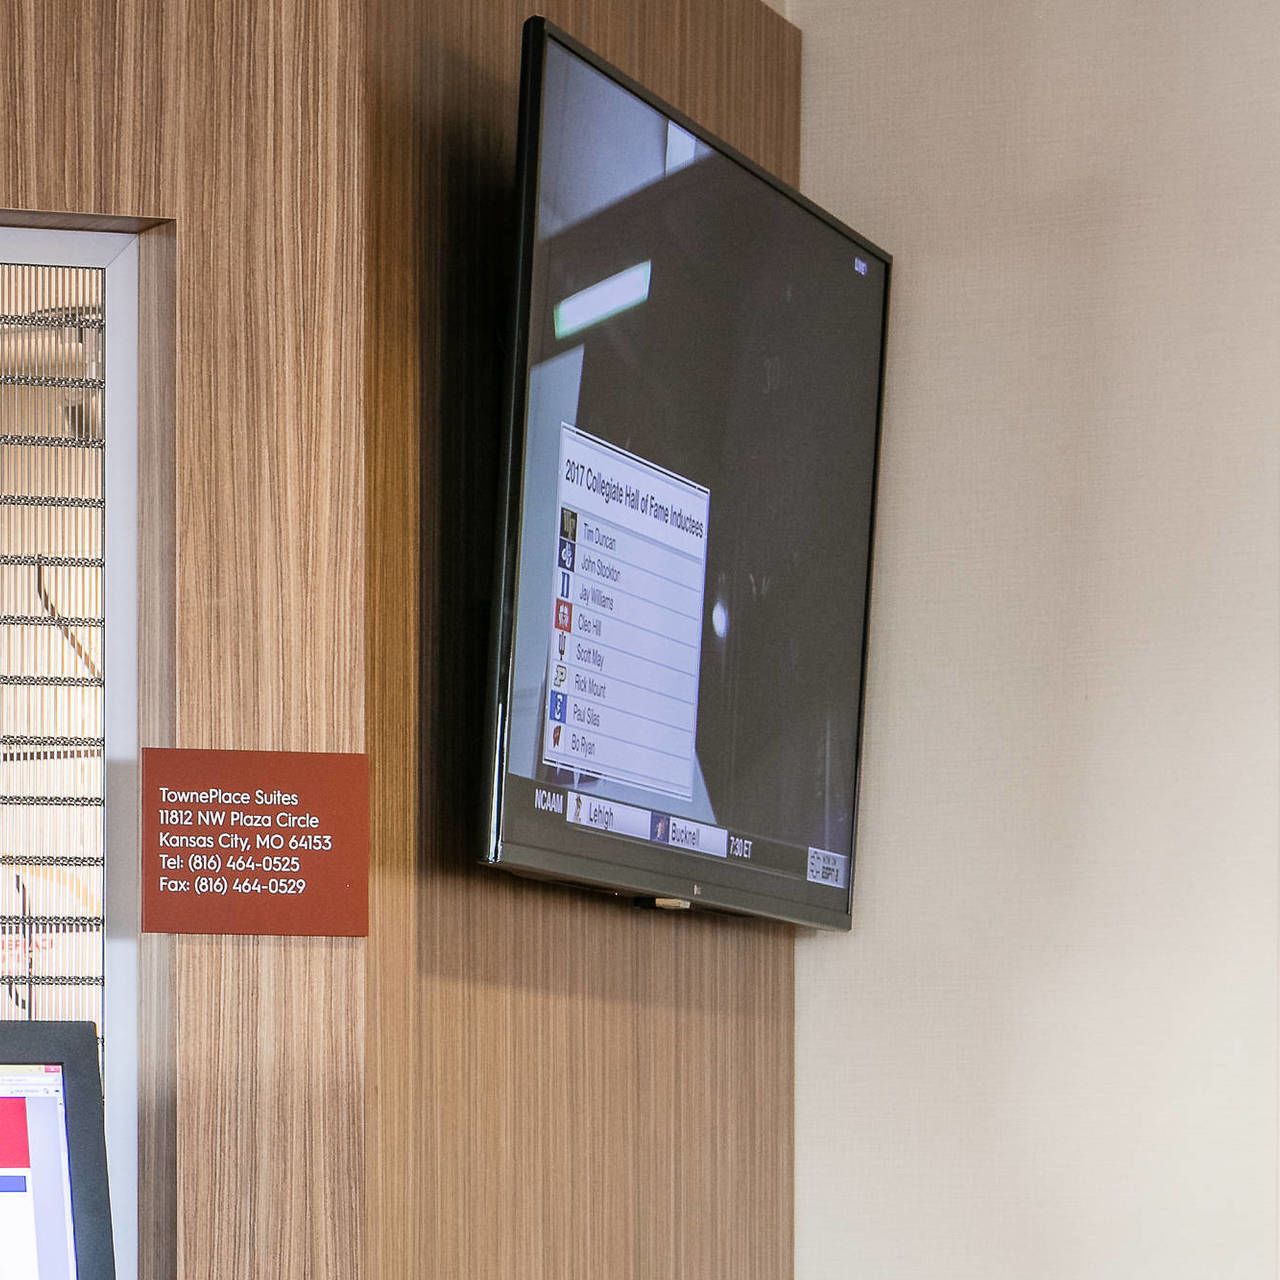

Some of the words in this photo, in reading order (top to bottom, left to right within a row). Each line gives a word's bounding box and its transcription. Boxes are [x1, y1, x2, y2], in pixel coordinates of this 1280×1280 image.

[565, 458, 585, 487] 2017
[586, 468, 624, 504] Collegiate
[625, 484, 640, 511] Hall
[641, 493, 649, 513] of
[649, 496, 669, 524] Fame
[670, 505, 704, 538] Inductees
[584, 522, 594, 541] Tim
[595, 528, 617, 551] Duncan
[581, 554, 596, 572] John
[596, 559, 621, 582] Stockton
[579, 583, 590, 605] Jay
[591, 585, 614, 611] Williams
[578, 613, 592, 633] Cleo
[576, 643, 592, 663] Scott
[592, 648, 605, 671] May
[575, 674, 587, 692] Rick
[589, 677, 606, 699] Mount
[573, 703, 586, 722] Paul
[587, 707, 600, 728] Silas
[571, 734, 580, 752] Bo
[581, 736, 596, 758] Ryan
[159, 787, 250, 805] TownePlace
[255, 789, 299, 806] Suites
[159, 809, 192, 826] 11812
[197, 811, 226, 826] NW
[230, 812, 272, 827] Plaza
[276, 812, 320, 828] Circle
[534, 788, 563, 814] NCAAM
[589, 802, 614, 830] Lehigh
[671, 821, 700, 847] Bucknell
[729, 836, 743, 857] 7:30
[743, 840, 753, 859] ET
[159, 832, 214, 848] Kansas
[218, 833, 251, 852] City,
[256, 834, 284, 850] MO
[288, 835, 332, 851] 64153
[159, 854, 184, 870] Tel:
[188, 854, 221, 873] (816)
[226, 856, 300, 872] 464-0525
[159, 877, 190, 892] Fax:
[194, 876, 228, 895] (816)
[232, 878, 306, 894] 464-0529
